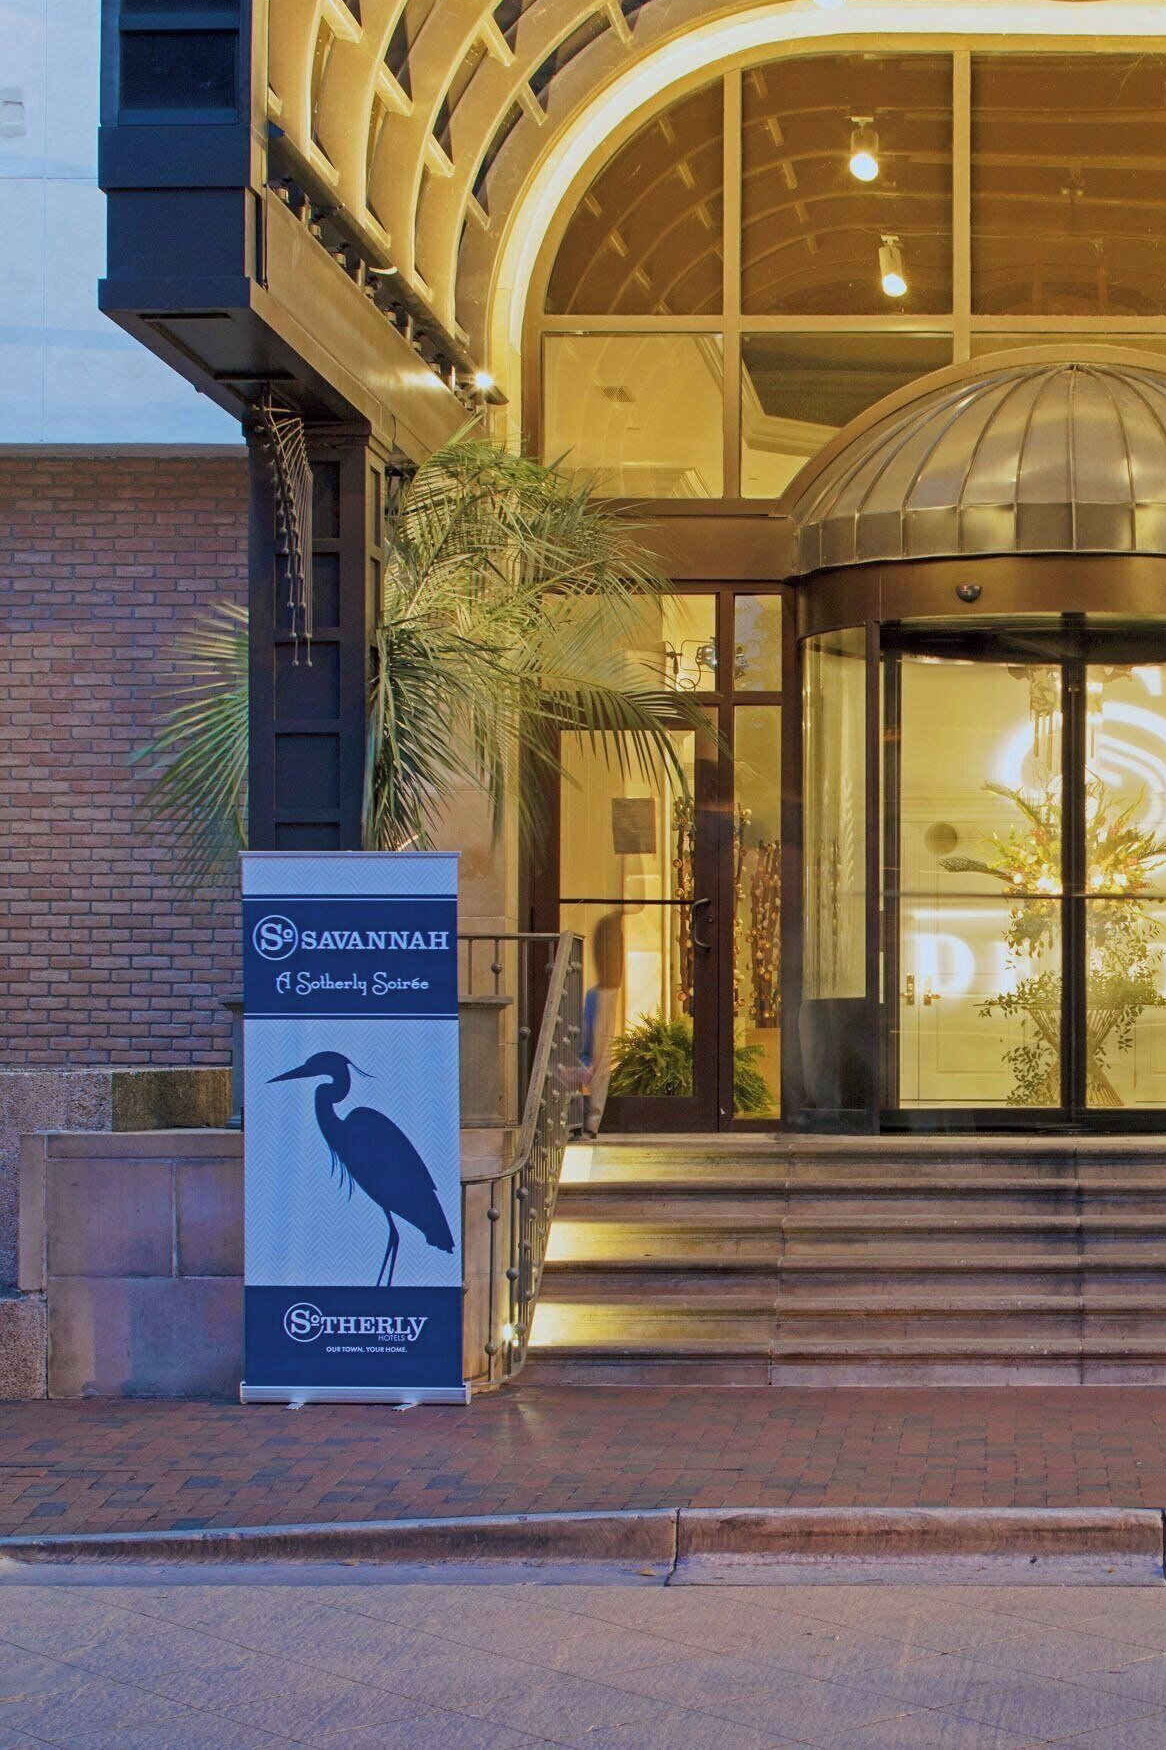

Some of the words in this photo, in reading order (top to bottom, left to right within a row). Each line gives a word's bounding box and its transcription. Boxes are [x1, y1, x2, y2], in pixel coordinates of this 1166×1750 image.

[301, 931, 449, 950] SAVANNAH
[276, 971, 292, 994] A
[295, 971, 368, 996] Sotherly
[372, 971, 430, 996] Soirée
[377, 1334, 406, 1342] HOTELS
